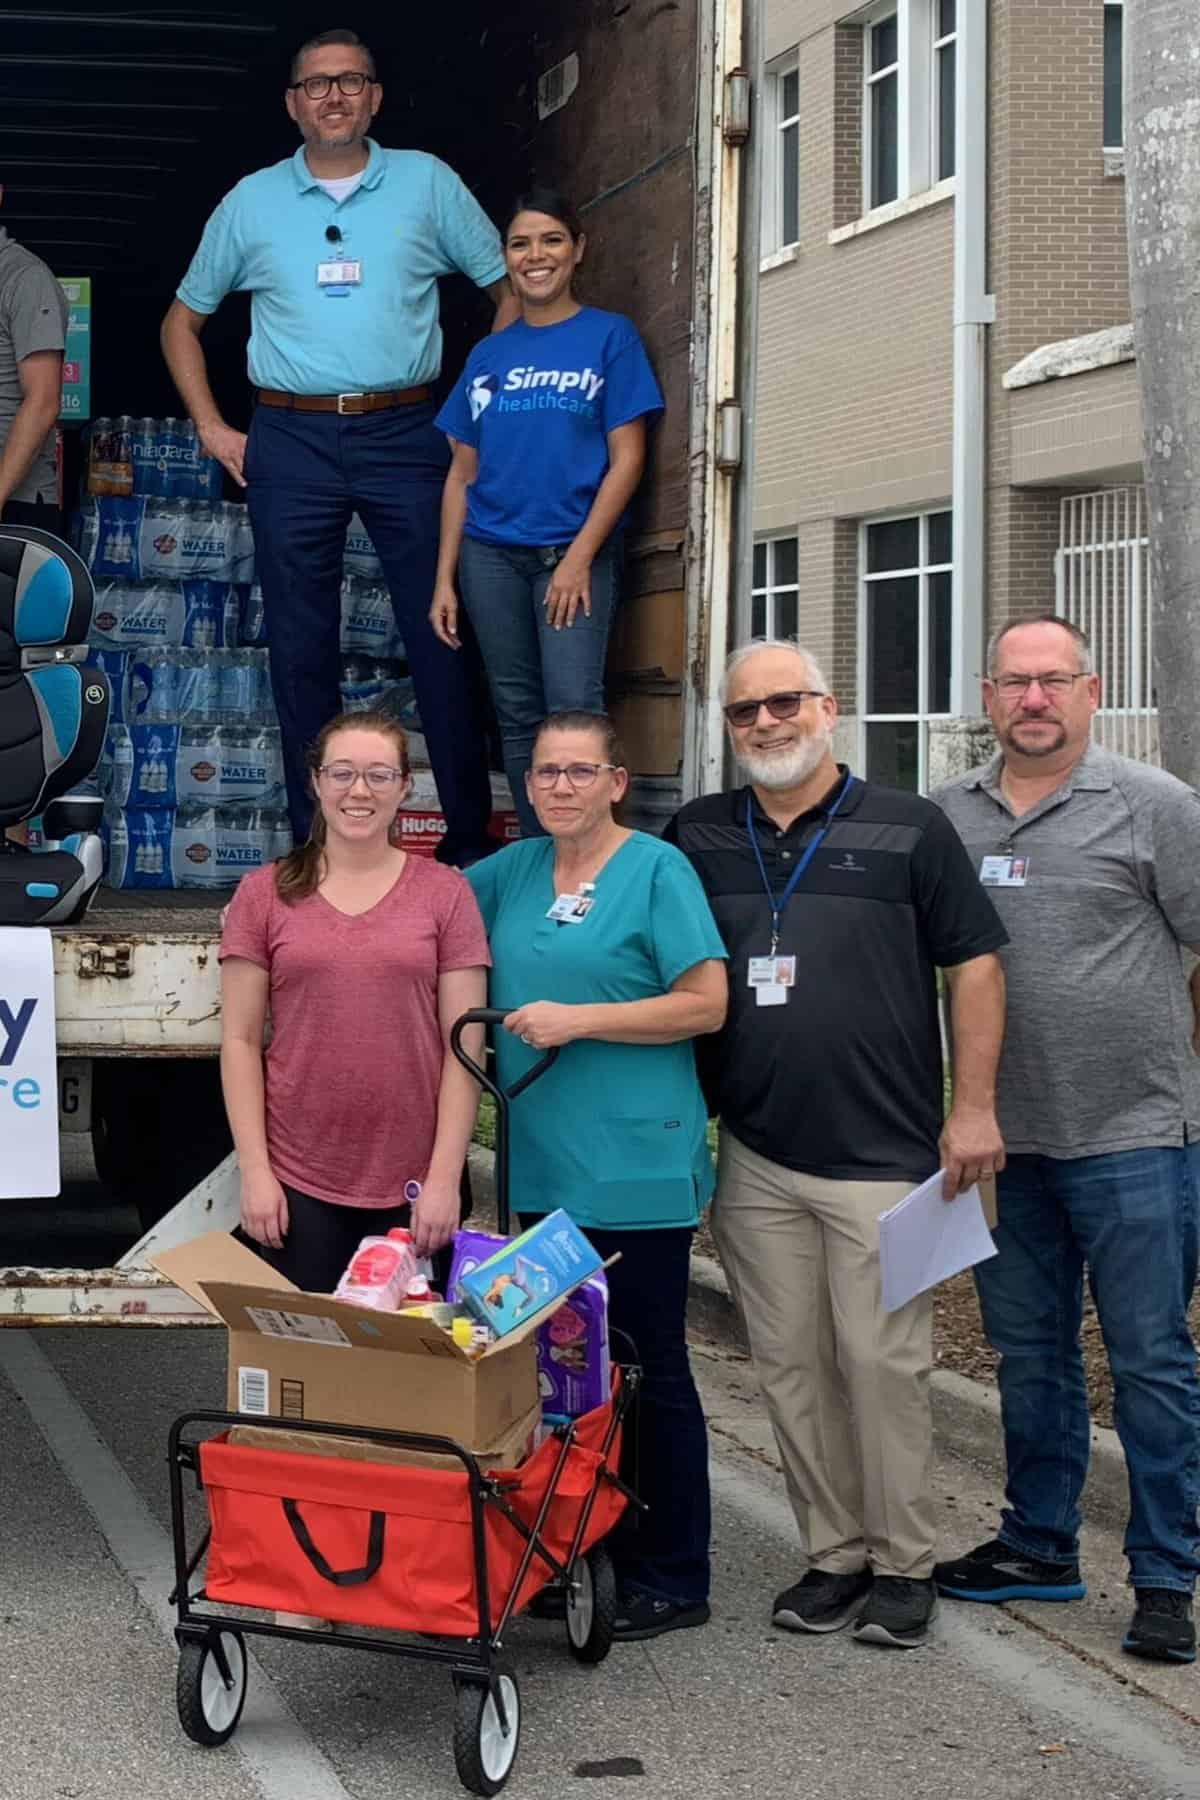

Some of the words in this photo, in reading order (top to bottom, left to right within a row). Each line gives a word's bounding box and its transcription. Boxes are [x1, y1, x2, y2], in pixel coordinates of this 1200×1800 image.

[503, 366, 604, 401] Simply
[182, 540, 225, 550] WATER
[345, 540, 375, 552] ATE
[120, 617, 167, 629] WATER
[221, 766, 267, 778] WATER
[401, 817, 448, 833] HUGG
[216, 848, 262, 860] WATER
